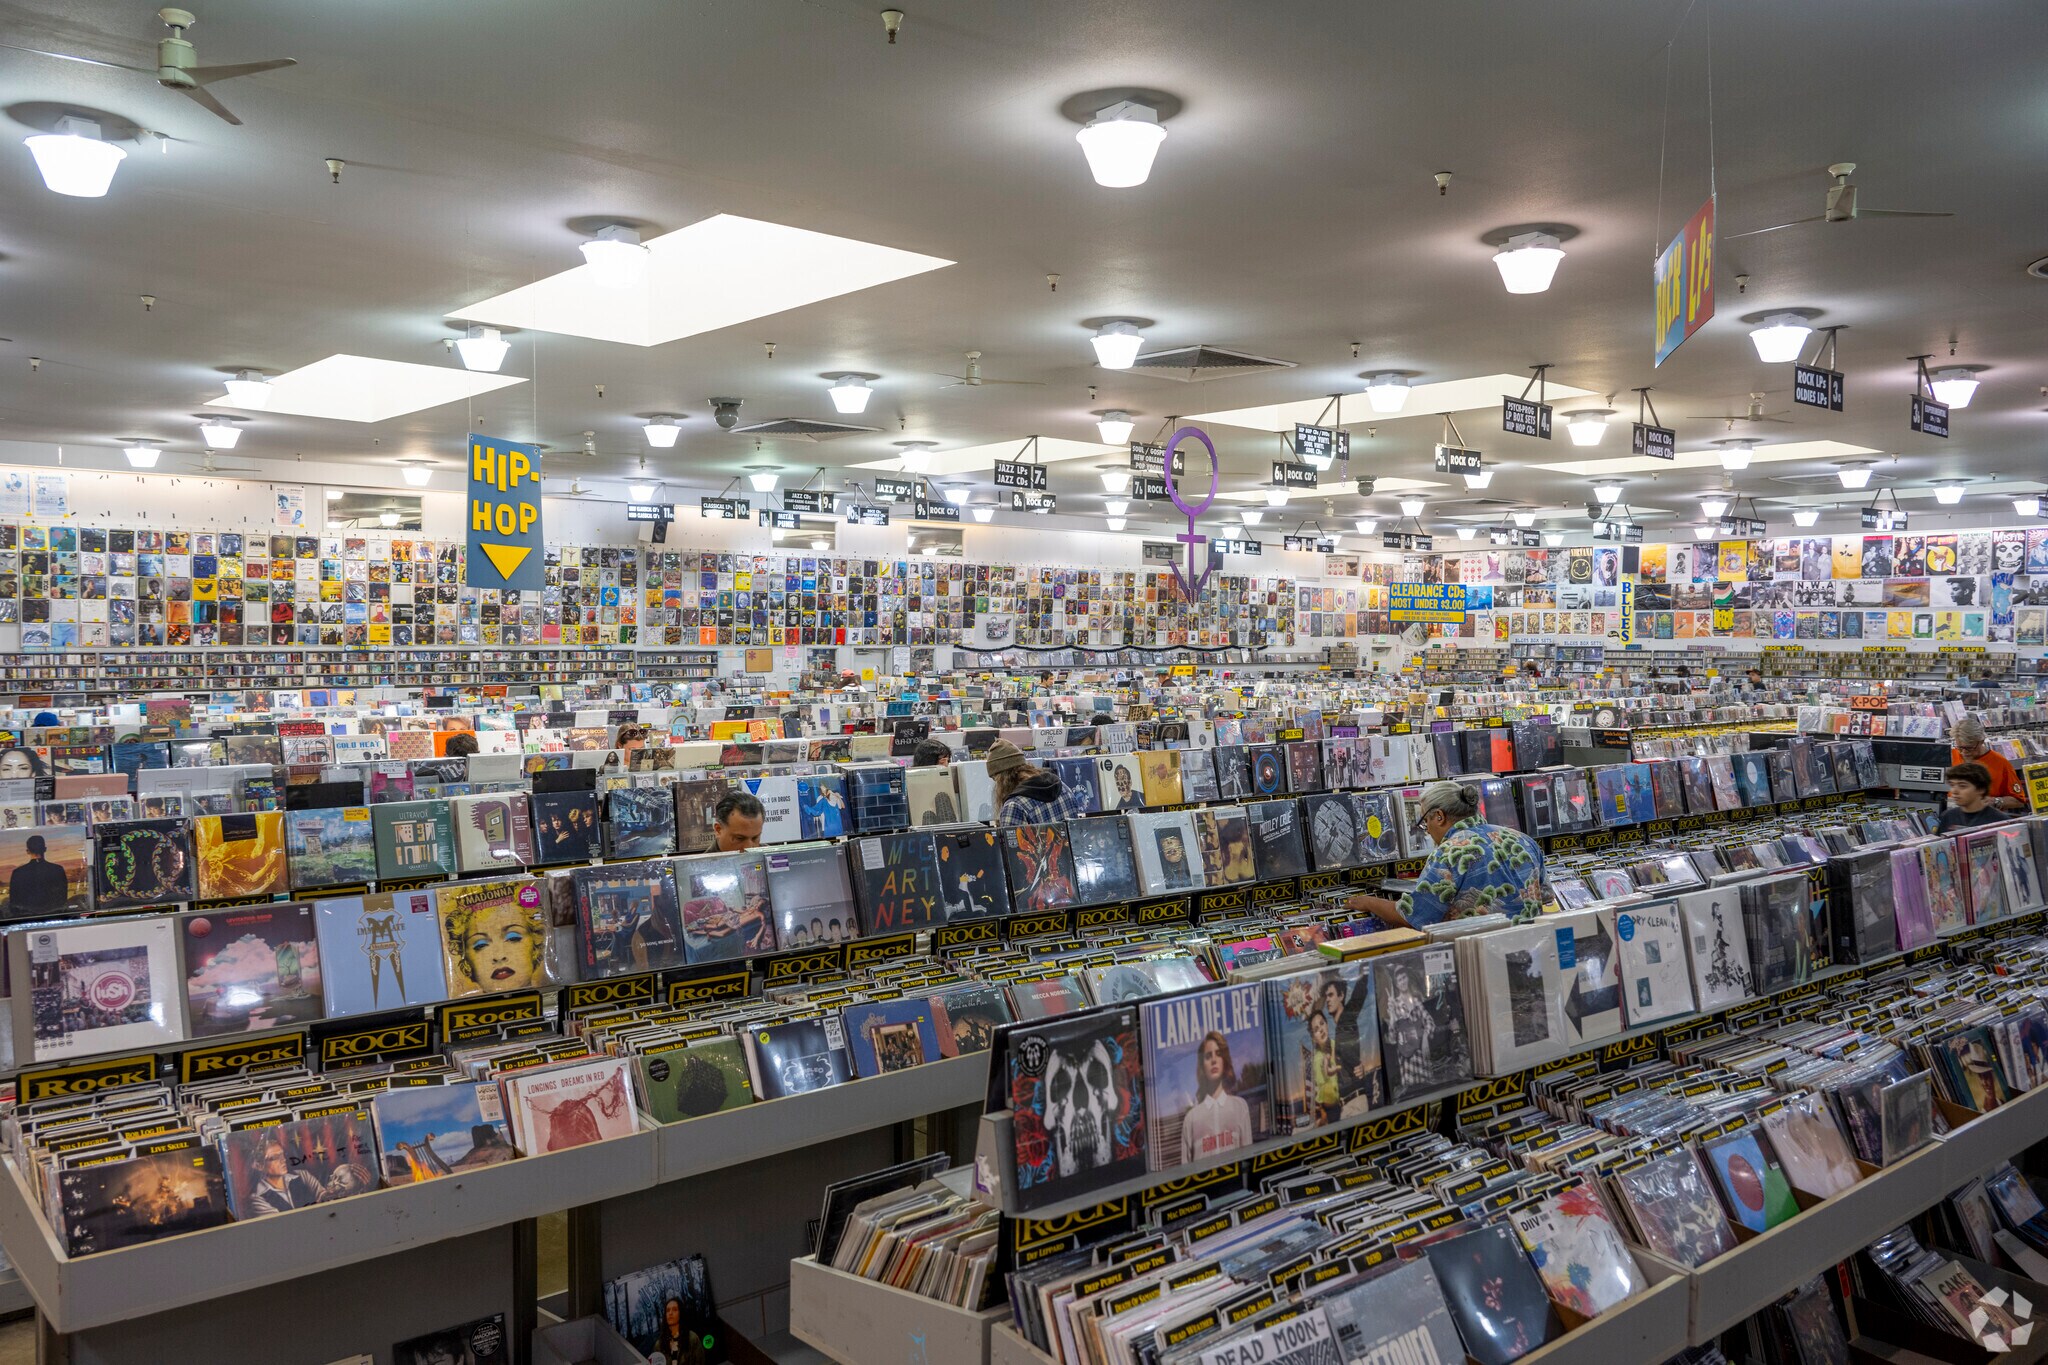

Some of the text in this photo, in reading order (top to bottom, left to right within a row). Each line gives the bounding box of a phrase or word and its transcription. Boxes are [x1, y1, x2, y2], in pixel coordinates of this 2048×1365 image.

[1656, 216, 1712, 353] ROCK LPs
[1798, 371, 1827, 389] ROCK LPs
[1796, 388, 1827, 406] OLDIES LPs
[1508, 402, 1535, 415] PSYCH-PROG
[1506, 410, 1536, 425] LP BOX SETS
[1506, 421, 1514, 431] HIP
[1516, 422, 1526, 432] HOP
[1649, 432, 1672, 445] ROCK CDs
[1646, 444, 1673, 459] OLDIES CDs
[474, 444, 539, 492] HIP-
[1173, 454, 1183, 470] 6a
[1450, 455, 1481, 468] ROCK CD's
[998, 464, 1028, 476] JAZZ LPs
[1034, 470, 1046, 485] 7a
[1274, 465, 1283, 479] 6b
[1288, 470, 1317, 482] ROCK CD's
[997, 474, 1028, 487] JAZZ CDs
[876, 484, 911, 496] JAZZ CD's
[1026, 498, 1042, 507] ROCK
[472, 500, 538, 536] HOP
[930, 506, 959, 516] ROCK CD's
[778, 520, 794, 529] PUNK
[1391, 584, 1466, 598] CLEARANCE CDs
[1390, 598, 1466, 610] MOST UNDER $3.00!
[1622, 582, 1632, 642] BLUES
[1852, 696, 1887, 708] K-POP
[1780, 801, 1801, 812] ROCK
[1805, 798, 1823, 810] ROCK
[1826, 794, 1844, 806] ROCK
[399, 809, 428, 820] ULTRAVOX
[1732, 808, 1753, 821] ROCK
[1757, 804, 1775, 814] ROCK
[1679, 816, 1701, 830] ROCK
[1706, 811, 1726, 824] ROCK
[1649, 820, 1671, 832] ROCK
[1553, 836, 1580, 850] ROCK
[1587, 833, 1612, 847] ROCK
[1618, 829, 1643, 843] ROCK
[1352, 865, 1386, 881] ROCK
[881, 867, 932, 897] ART
[1302, 873, 1338, 890] ROCK
[464, 886, 515, 905] MADONNA
[1255, 884, 1293, 901] ROCK
[1203, 893, 1246, 910] ROCK
[876, 897, 935, 929] NEY
[1079, 907, 1126, 926] ROCK
[1141, 902, 1186, 922] ROCK
[1012, 916, 1066, 936] ROCK
[941, 924, 995, 945] ROCK
[854, 943, 909, 961] ROCK
[773, 956, 836, 978] ROCK
[573, 978, 650, 1006] ROCK
[676, 982, 742, 999] ROCK
[822, 991, 844, 999] MATTHEWS
[1032, 989, 1071, 1000] MECCA NORMAL
[454, 1007, 534, 1029] ROCK
[593, 1018, 615, 1026] MANFRED
[1155, 987, 1261, 1050] LANA DEL REY
[472, 1029, 490, 1037] SEASON
[518, 1026, 543, 1036] MADONNA
[328, 1027, 423, 1058] ROCK
[645, 1042, 684, 1055] MAGDALENA BAY
[1606, 1034, 1655, 1059] ROCK
[195, 1047, 294, 1073] ROCK
[559, 1049, 588, 1060] MACALPINE
[35, 1071, 146, 1099] ROCK
[304, 1086, 322, 1094] LOWE
[527, 1072, 604, 1094] LONGINGS DREAMS IN RED
[1462, 1073, 1521, 1109] ROCK
[220, 1101, 243, 1109] LOWER
[305, 1112, 321, 1120] LOVE
[329, 1106, 355, 1115] ROCKETS
[244, 1119, 282, 1131] LOVE-BIRDS
[1356, 1107, 1426, 1148] ROCK
[77, 1137, 110, 1148] LOFGREN
[150, 1142, 190, 1154] LIVE SKULL
[1202, 1130, 1234, 1153] BORN TO DIE
[1345, 1173, 1373, 1186] DEVOTCHKA
[1306, 1186, 1320, 1196] DEVO
[1456, 1181, 1482, 1197] DIRE STRAITS
[1167, 1202, 1203, 1220] MAC DEMARCO
[1244, 1201, 1276, 1219] LANA DEL REY
[1195, 1219, 1228, 1238] MORGAN DELT
[1520, 1216, 1540, 1232] DIIV
[1136, 1256, 1166, 1273] DEEP TIME
[1315, 1267, 1340, 1281] DEFTONES
[1084, 1274, 1123, 1294] DEEP PURPLE
[1938, 1272, 1970, 1297] CAKE
[1232, 1297, 1272, 1322] DEAD OR ALIVE
[1170, 1317, 1214, 1344] DEAD WEATHER
